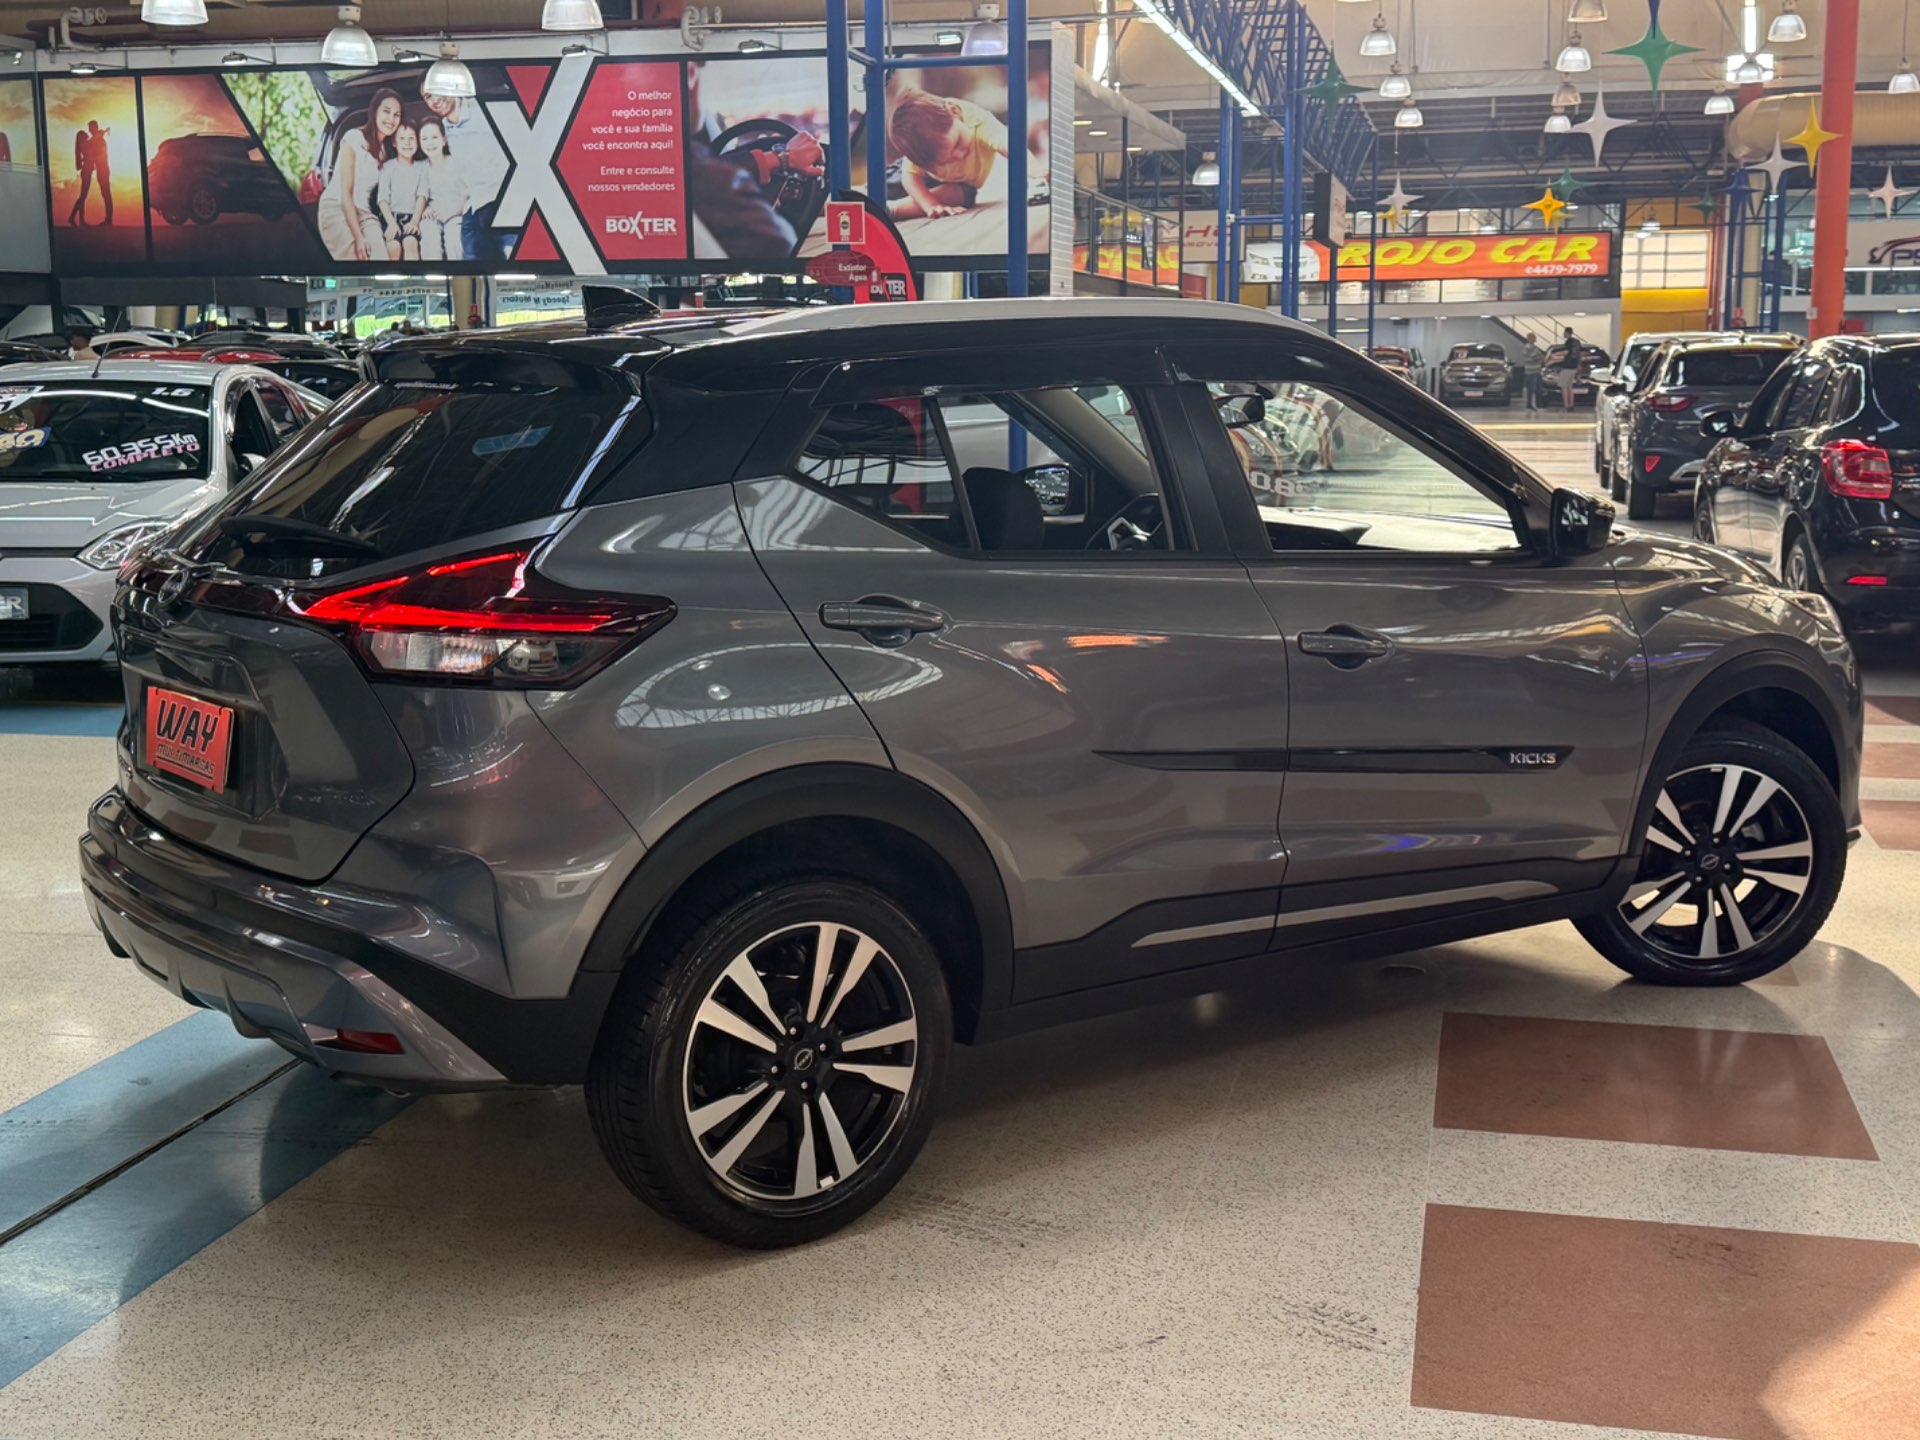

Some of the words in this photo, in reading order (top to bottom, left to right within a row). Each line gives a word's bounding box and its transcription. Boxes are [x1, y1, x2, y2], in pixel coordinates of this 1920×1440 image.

[627, 90, 637, 100] O
[639, 90, 672, 100] melhor
[611, 107, 650, 119] negócio
[652, 108, 673, 118] para
[591, 124, 614, 134] você
[616, 125, 622, 133] e
[624, 125, 640, 133] sua
[642, 123, 673, 133] família
[582, 141, 605, 150] você
[607, 141, 649, 150] encontra
[650, 139, 673, 151] aqui!
[600, 166, 625, 176] Entre
[635, 165, 675, 175] consulte
[588, 183, 620, 192] nossos
[622, 181, 676, 192] vendedores
[605, 211, 677, 240] BOXTER
[1337, 239, 1477, 267] ROJO
[1489, 235, 1599, 264] CAR
[838, 263, 867, 272] Extintor
[848, 272, 868, 282] Água
[151, 386, 195, 397] 1.6
[91, 442, 201, 472] COMPLETO
[156, 699, 220, 754] WAY
[1509, 752, 1557, 764] KICKS
